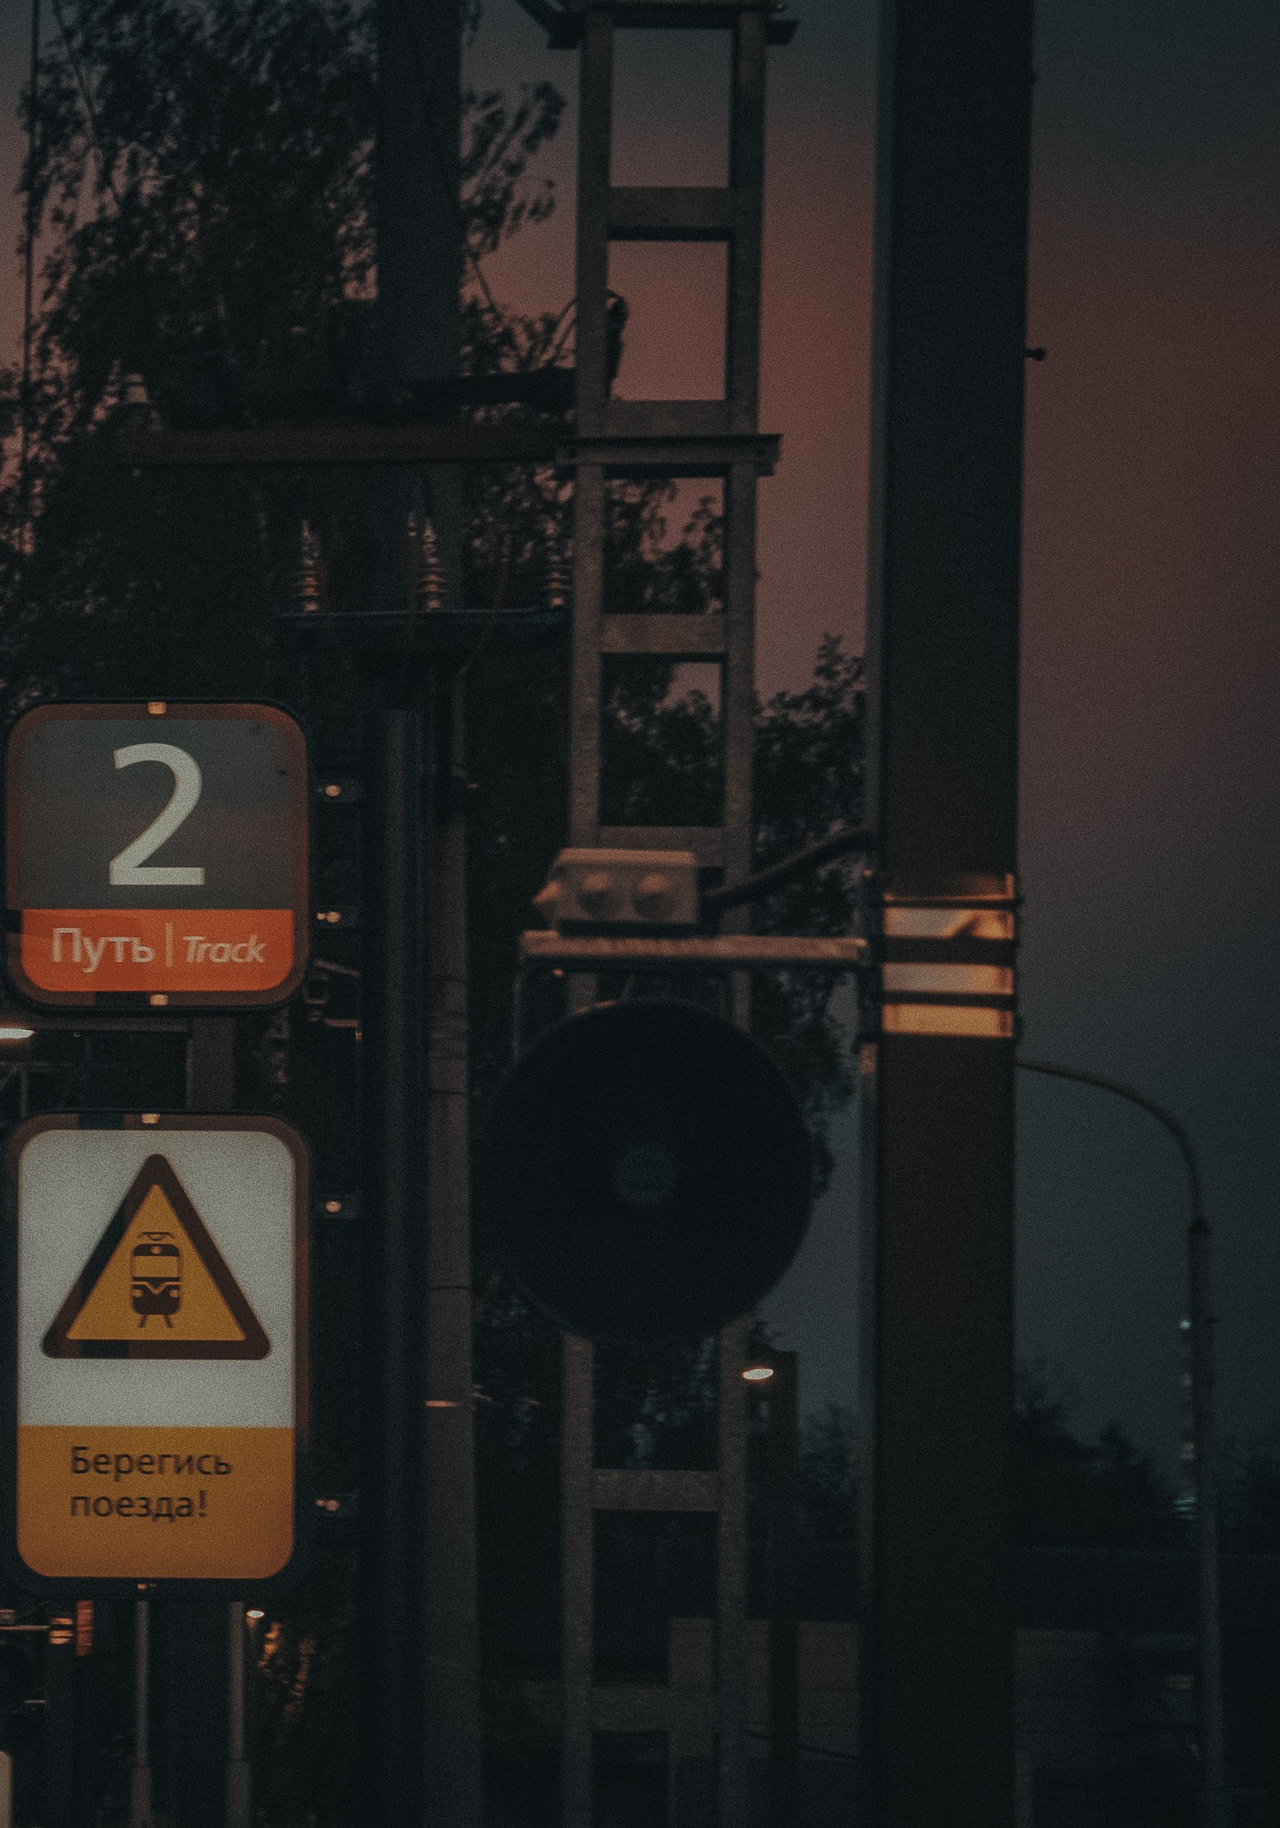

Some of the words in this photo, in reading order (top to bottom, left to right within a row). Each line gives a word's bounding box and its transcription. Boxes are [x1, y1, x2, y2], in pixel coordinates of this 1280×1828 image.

[109, 742, 206, 887] 2
[52, 927, 156, 973] Путь
[183, 934, 268, 964] Track
[70, 1446, 233, 1482] Берегись
[70, 1490, 207, 1523] поезда!
